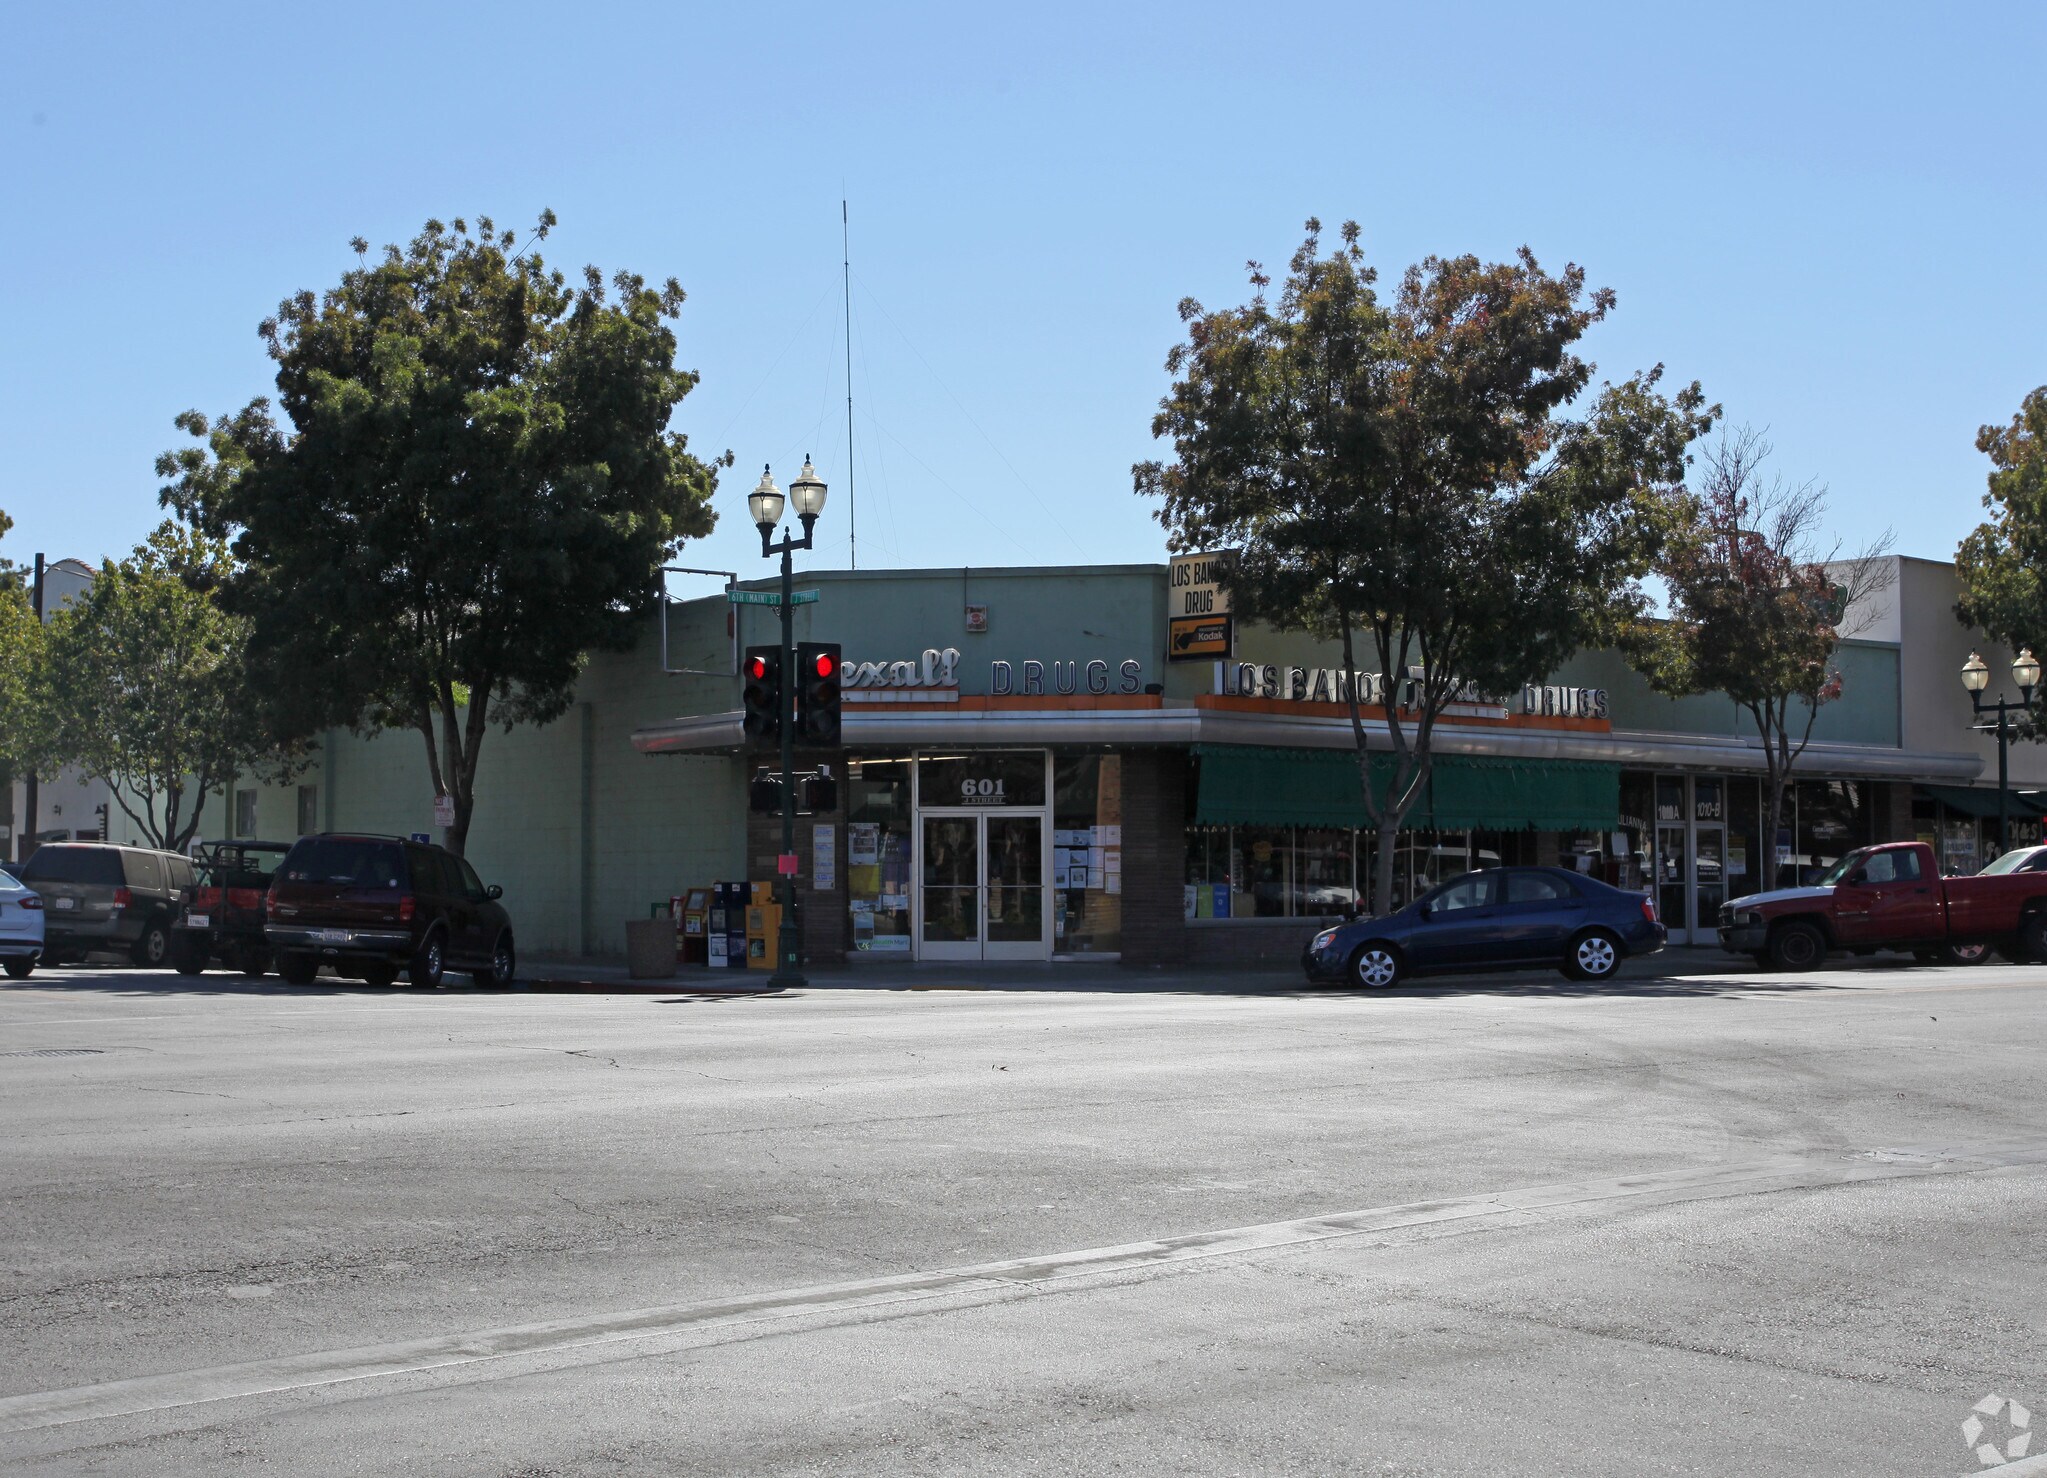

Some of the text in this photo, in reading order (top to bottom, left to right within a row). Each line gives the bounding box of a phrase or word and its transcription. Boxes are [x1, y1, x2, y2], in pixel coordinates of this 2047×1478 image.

[1171, 560, 1228, 588] LOS BAN
[731, 593, 777, 605] 6TH (MAIN) ST
[1185, 589, 1214, 614] DRUG
[1198, 631, 1224, 641] Kodak
[841, 648, 960, 688] exall
[992, 659, 1142, 696] DRUGS
[1214, 661, 1280, 699] LOS
[1523, 682, 1610, 720] DRUGS
[961, 778, 1005, 796] 601
[1697, 802, 1721, 817] 1010-B
